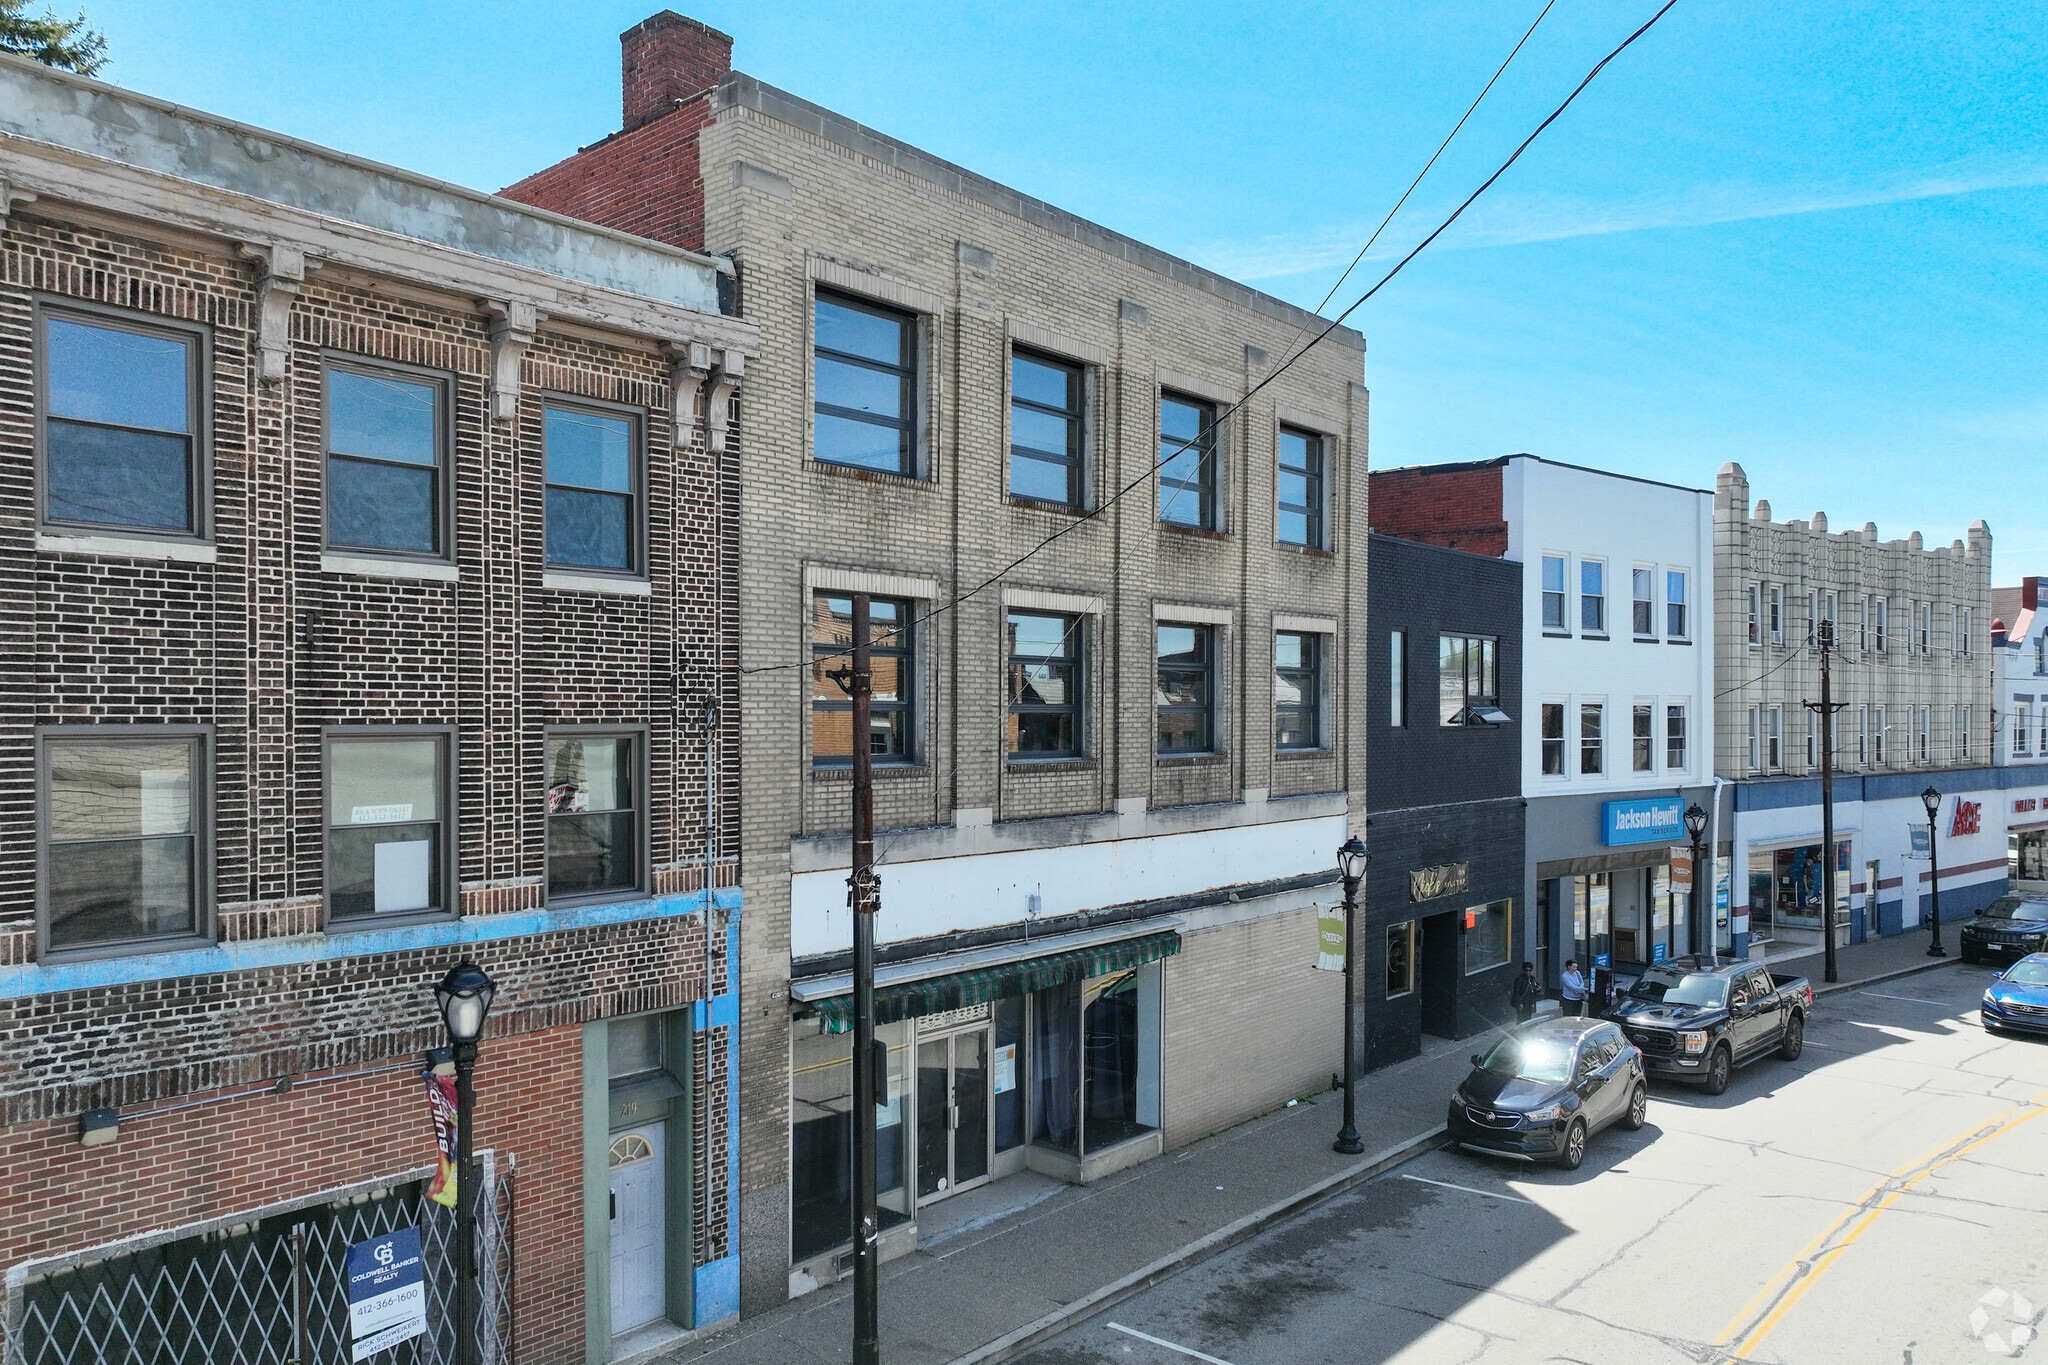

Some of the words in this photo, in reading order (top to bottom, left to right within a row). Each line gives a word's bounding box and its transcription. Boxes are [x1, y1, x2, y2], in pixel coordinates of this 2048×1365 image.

[1616, 809, 1650, 830] Jackson
[1652, 806, 1678, 826] Hewitt
[1951, 796, 1981, 837] ACE
[429, 1088, 449, 1153] BUILD
[621, 1101, 637, 1118] 219
[351, 1265, 390, 1283] COLDWELL
[391, 1257, 419, 1270] BANKER
[373, 1271, 399, 1285] REALTY
[357, 1288, 418, 1316] 412-366-1600
[357, 1339, 375, 1351] RICK
[376, 1319, 420, 1342] SCHWEIKERT
